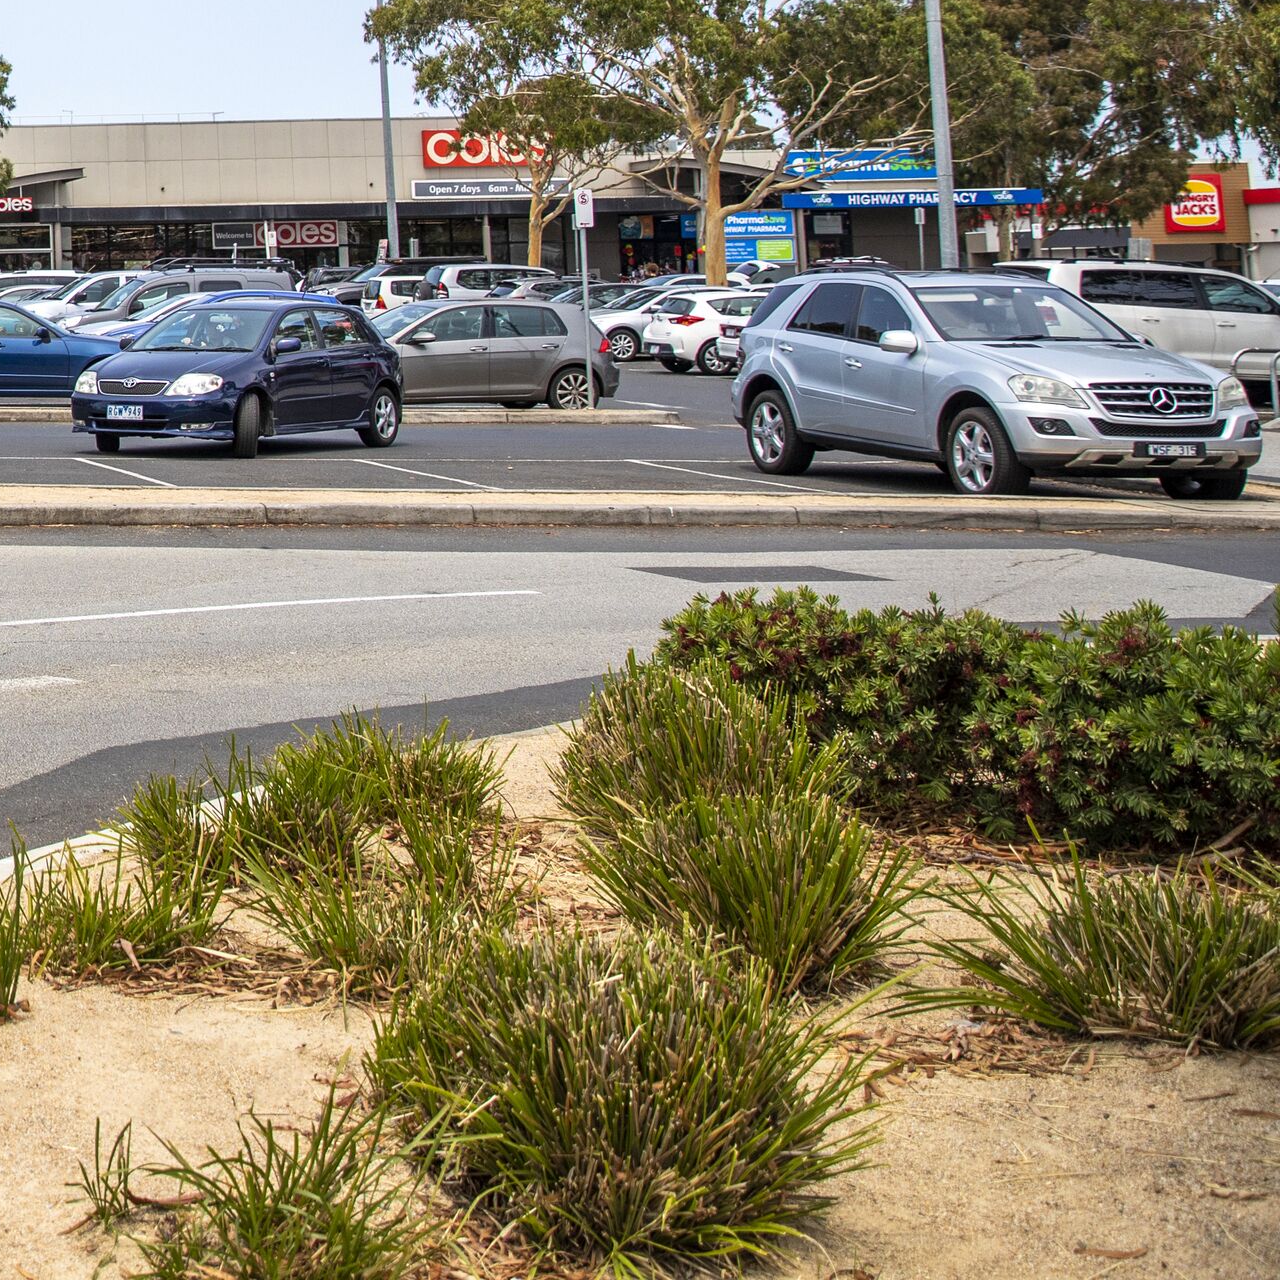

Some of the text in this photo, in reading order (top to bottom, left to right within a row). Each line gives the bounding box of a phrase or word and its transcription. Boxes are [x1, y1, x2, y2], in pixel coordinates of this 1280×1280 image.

[429, 185, 452, 195] Open
[454, 185, 459, 193] 7
[460, 184, 481, 195] days
[488, 184, 508, 193] 6am
[515, 183, 555, 195] Midht
[848, 191, 978, 206] HIGHWAY PHARACY
[1175, 204, 1216, 215] JACK'S
[727, 215, 786, 224] PharmaSave
[256, 221, 336, 244] coles
[724, 225, 787, 233] HWAY PHARMACY
